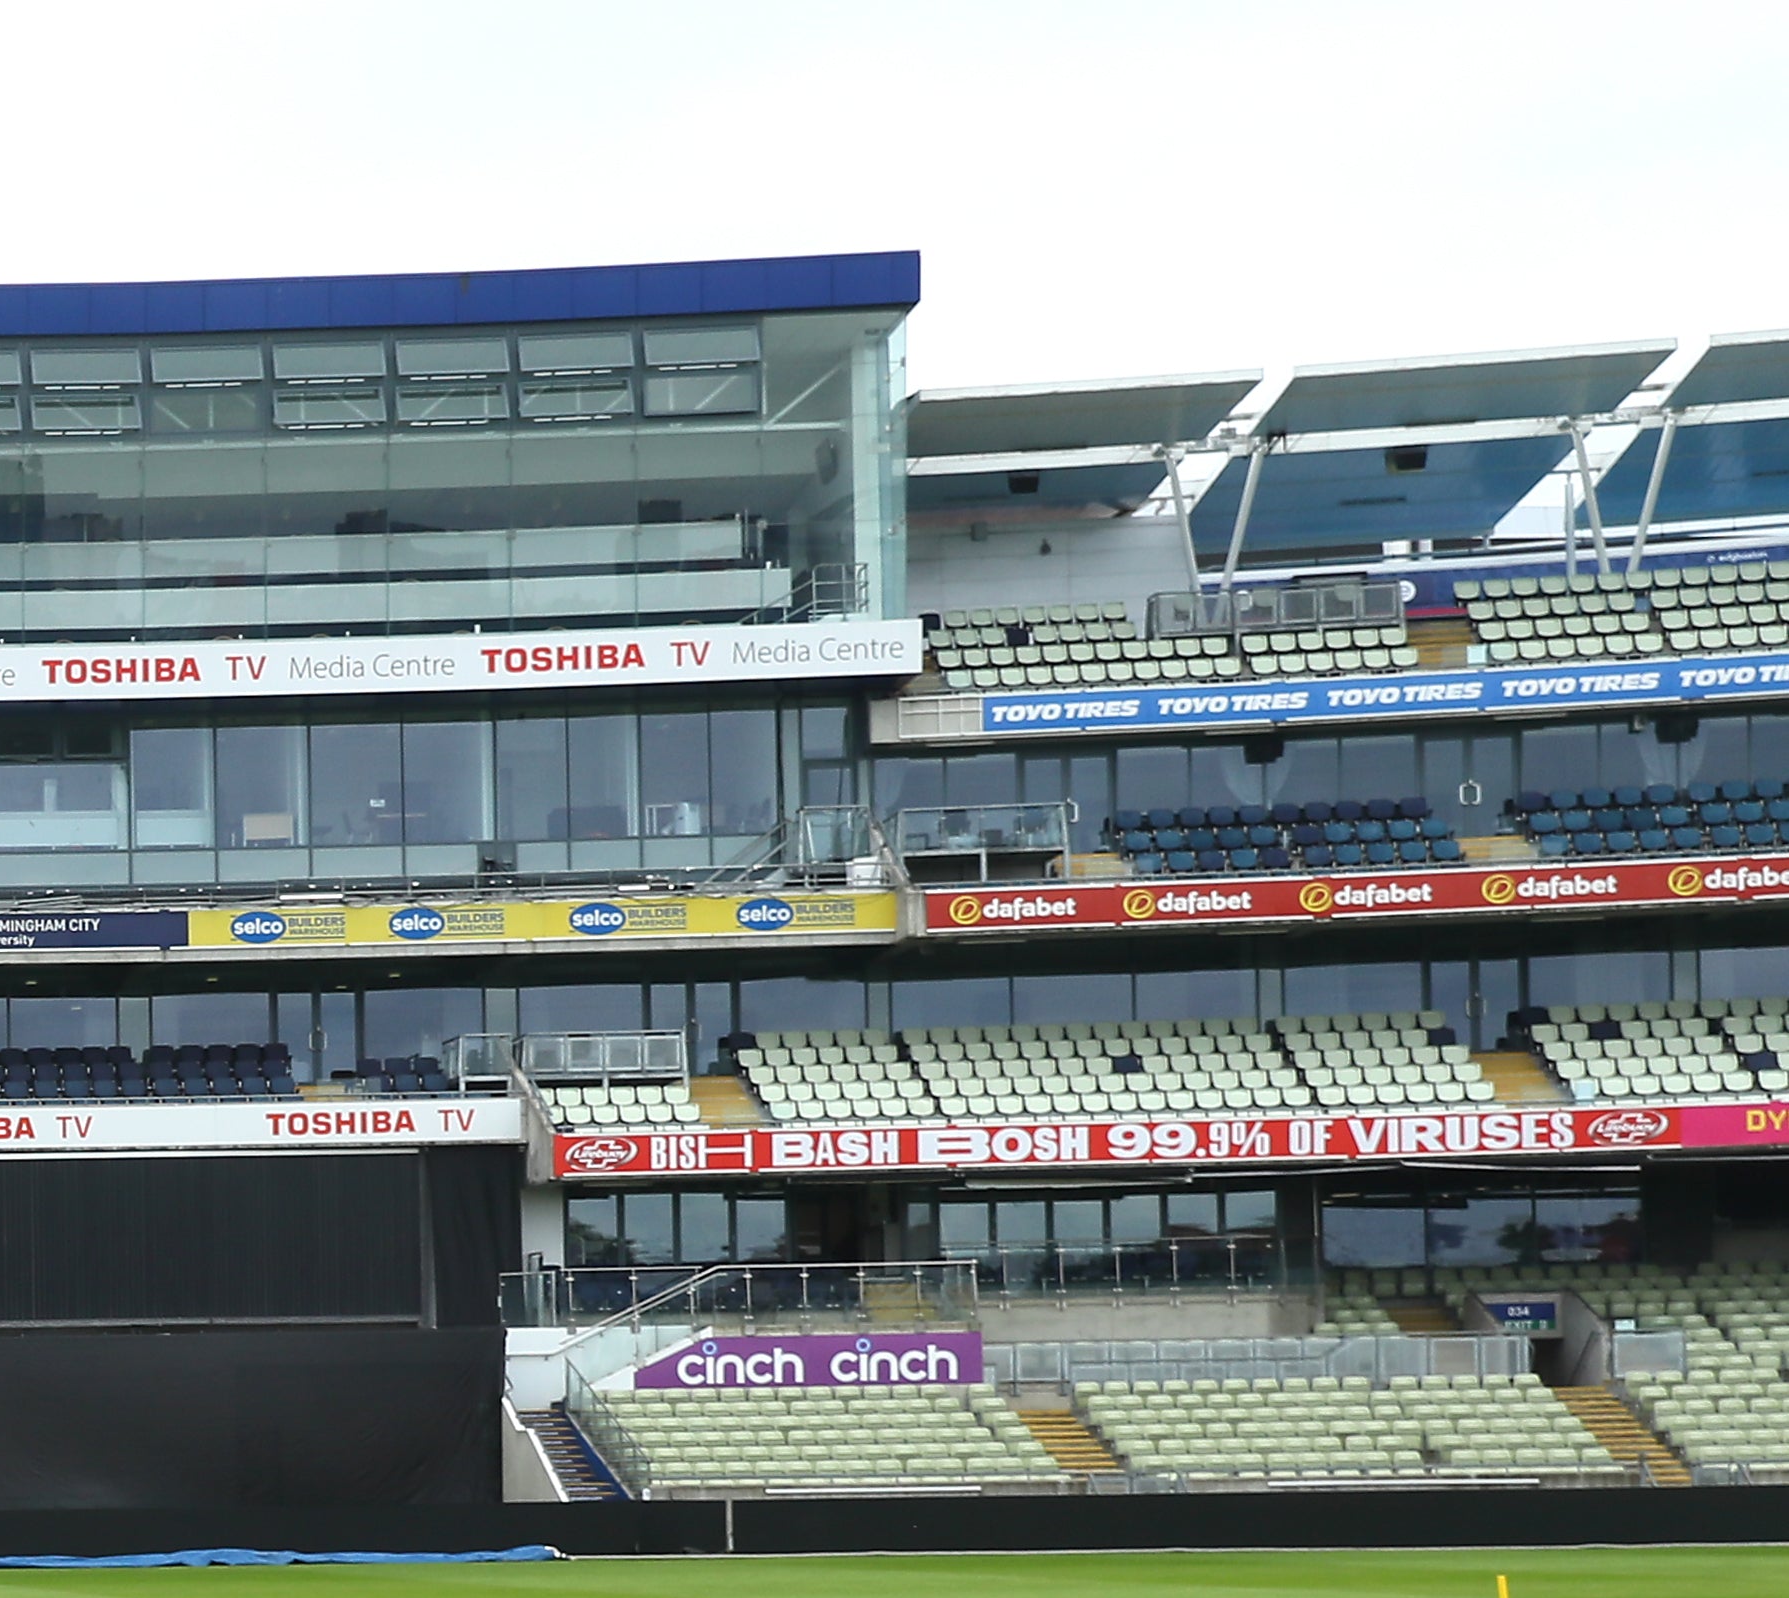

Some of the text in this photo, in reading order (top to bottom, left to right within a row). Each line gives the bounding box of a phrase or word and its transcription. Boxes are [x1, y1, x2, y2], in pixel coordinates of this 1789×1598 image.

[481, 636, 905, 674] TOSHIBA TV Media Centre
[42, 652, 456, 684] TOSHIBA TV Media Centre
[1679, 666, 1757, 688] TOYO
[1327, 682, 1484, 706] TOYO TIRES
[1502, 673, 1660, 697] TOYO TIRES
[992, 700, 1140, 722] TOYO TIRES
[1158, 692, 1309, 715] TOYO TIRES
[1333, 883, 1433, 907] dafabet
[1517, 874, 1617, 899] dafabet
[627, 905, 686, 920] BUILDERS
[795, 901, 854, 917] BUILDERS
[983, 896, 1076, 921] dafabet
[1156, 889, 1252, 914] dafabet
[69, 918, 101, 932] CITY
[288, 916, 345, 928] BUILDERS
[391, 914, 443, 933] selco
[447, 911, 505, 924] BUILDERS
[571, 909, 624, 928] selco
[739, 904, 791, 925] selco
[233, 917, 284, 936] selco
[448, 922, 505, 933] WAREHOUSE
[56, 1116, 93, 1139] TV
[265, 1109, 475, 1135] TOSHIBA TV
[650, 1111, 1575, 1170] BISH BASH BOSH 99.9% OF VIRUSES
[676, 1340, 804, 1385] cinch
[830, 1337, 958, 1382] cinch
